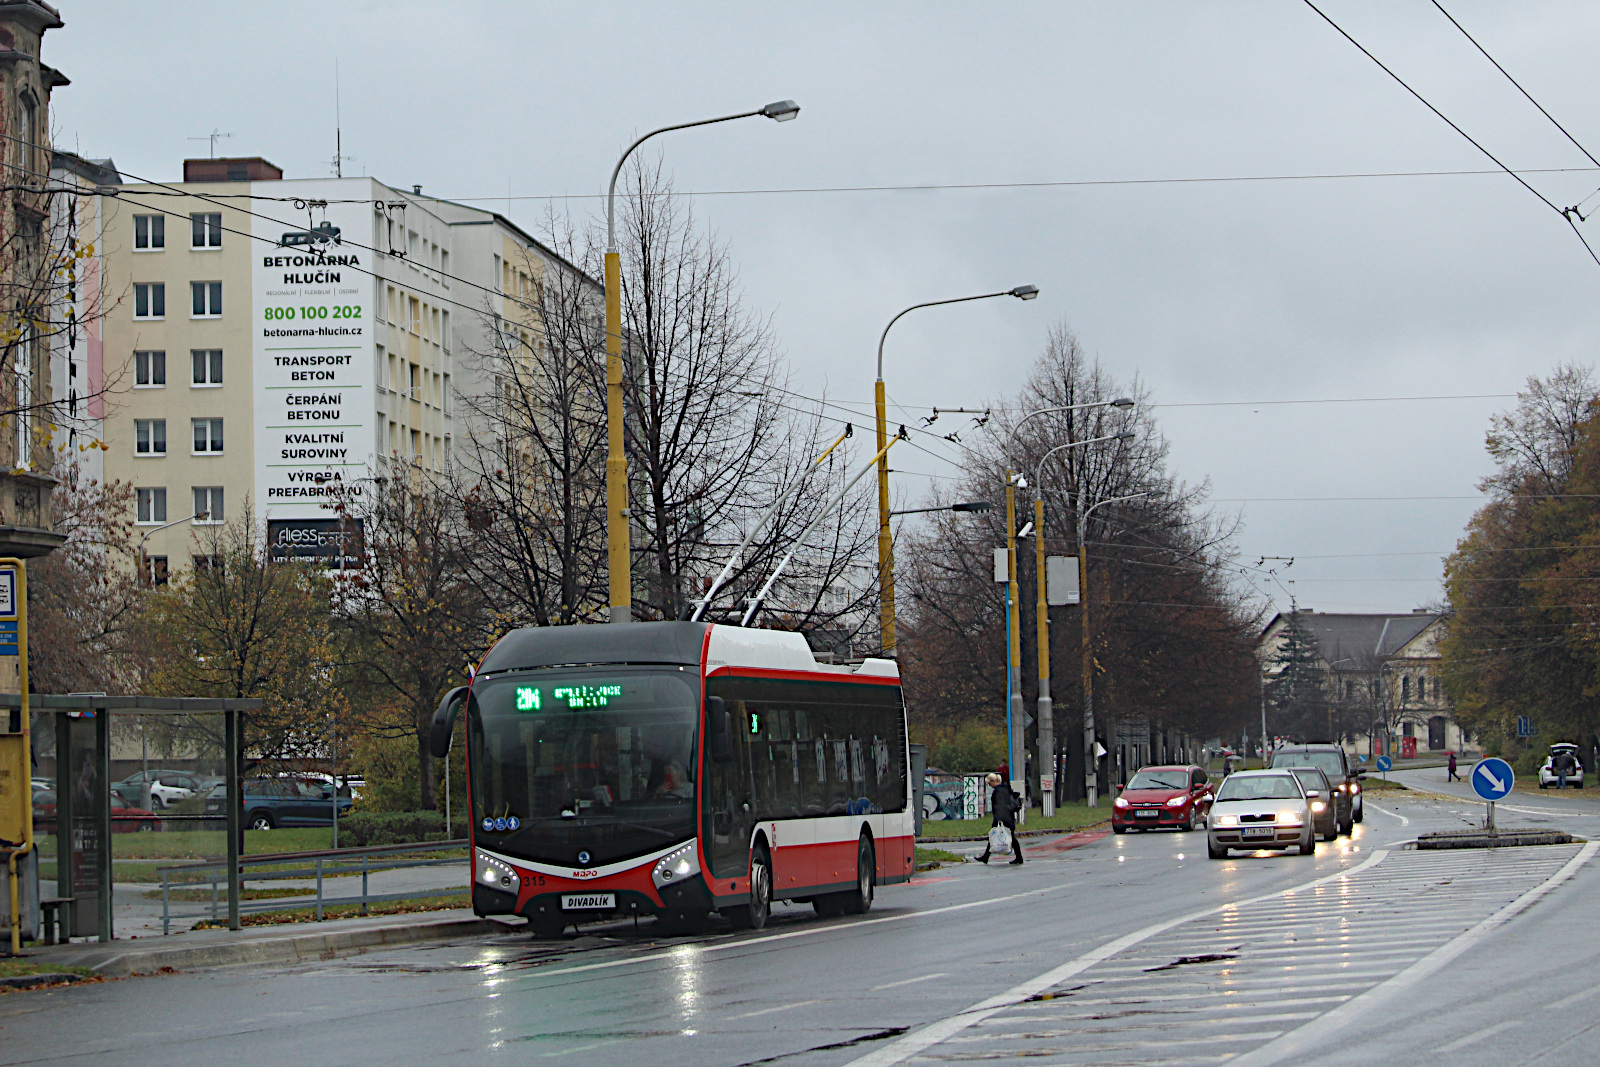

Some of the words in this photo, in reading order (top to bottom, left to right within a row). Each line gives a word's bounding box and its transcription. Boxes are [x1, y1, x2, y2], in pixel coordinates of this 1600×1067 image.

[284, 269, 341, 284] HLUČÍN
[264, 306, 296, 320] 800
[300, 305, 328, 319] 100
[332, 305, 362, 319] 202
[263, 326, 362, 337] betonarna-hlucin.cz
[274, 355, 352, 366] TRANSPORT
[291, 371, 335, 381] BETON
[286, 393, 342, 405] ČERPÁNÍ
[287, 410, 340, 420] BETONU
[285, 431, 344, 443] KVALITNÍ
[281, 448, 348, 458] SUROVINY
[523, 876, 546, 887] 315
[568, 895, 609, 907] DIVADLÍK
